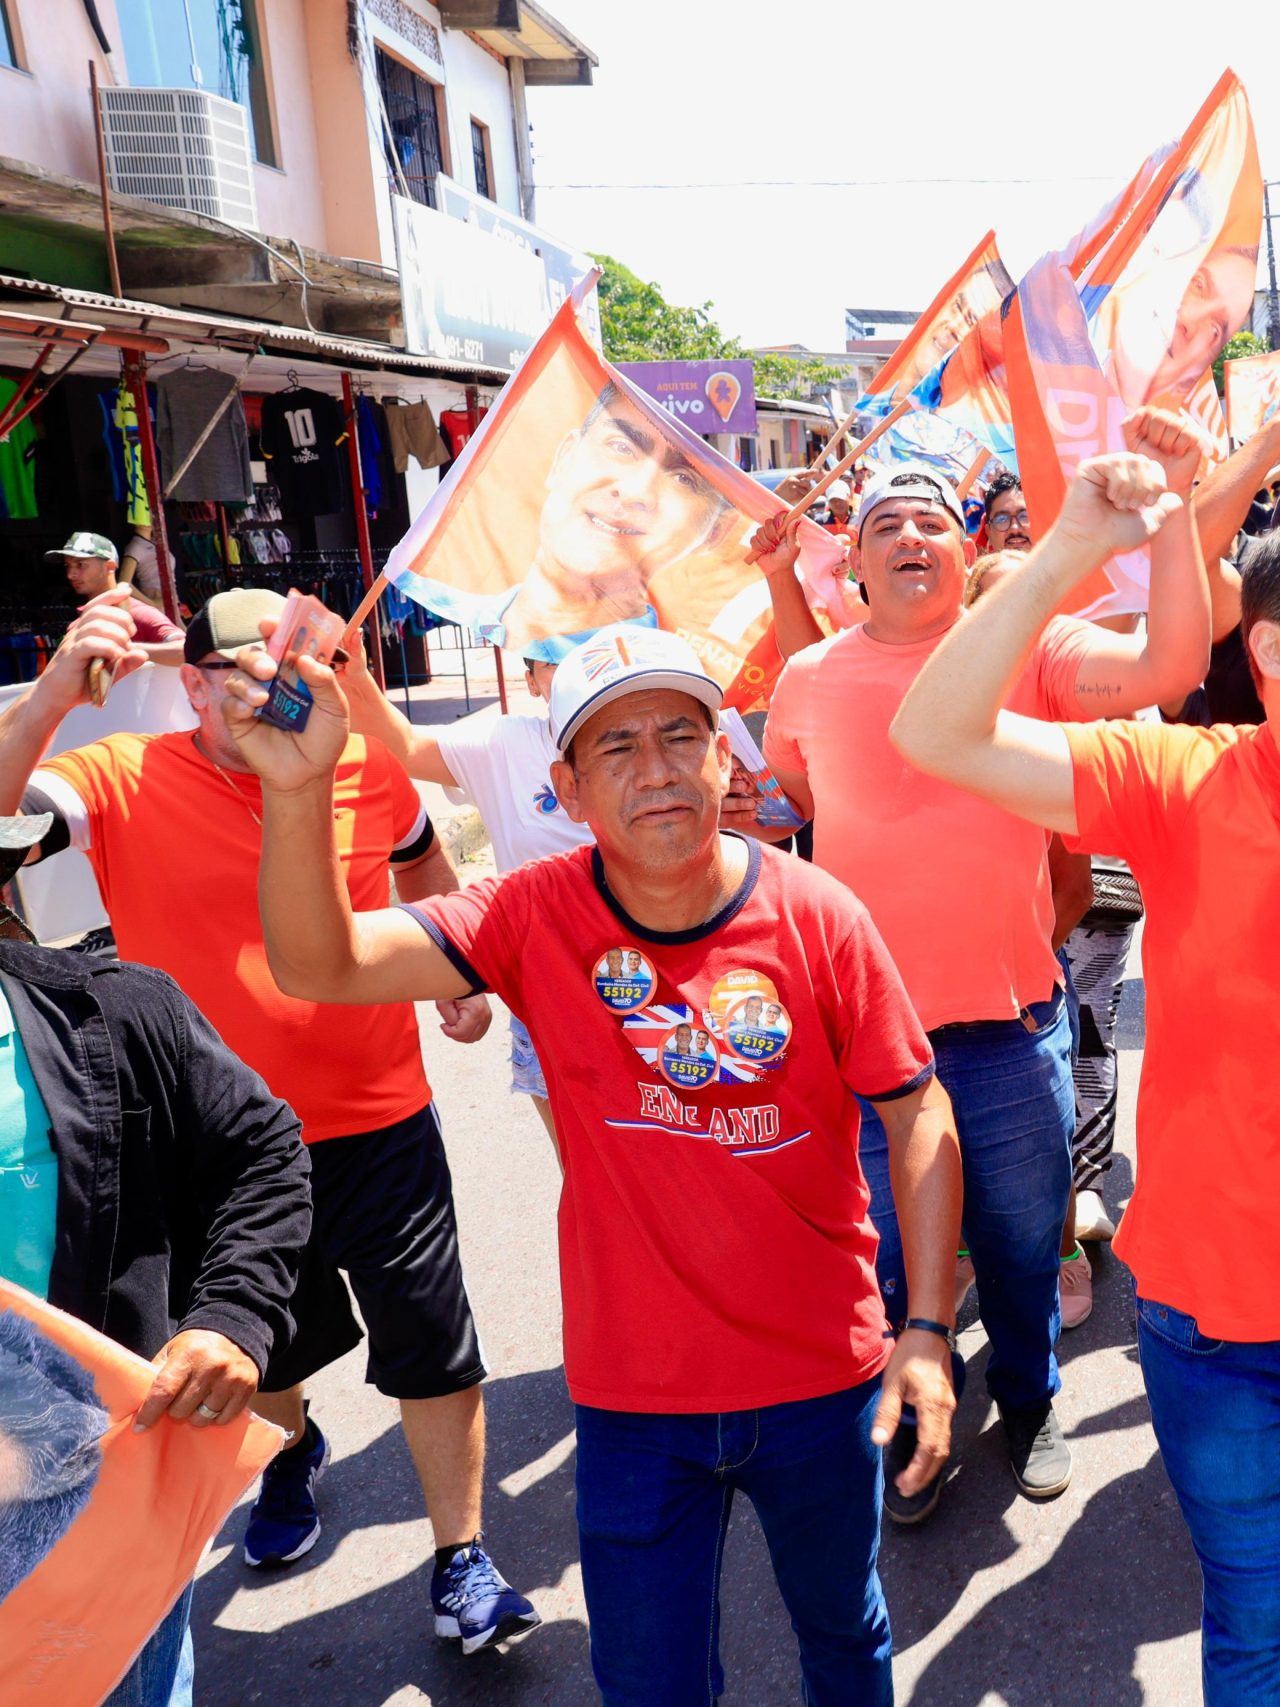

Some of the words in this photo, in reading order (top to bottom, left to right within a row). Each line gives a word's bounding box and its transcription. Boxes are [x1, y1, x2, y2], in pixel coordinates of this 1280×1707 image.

[657, 383, 678, 392] AQUI
[680, 382, 698, 391] TEM
[284, 408, 318, 448] 10
[727, 975, 759, 986] DAVID
[603, 986, 642, 999] 55192
[735, 1033, 775, 1052] 55192
[670, 1062, 707, 1078] 55192
